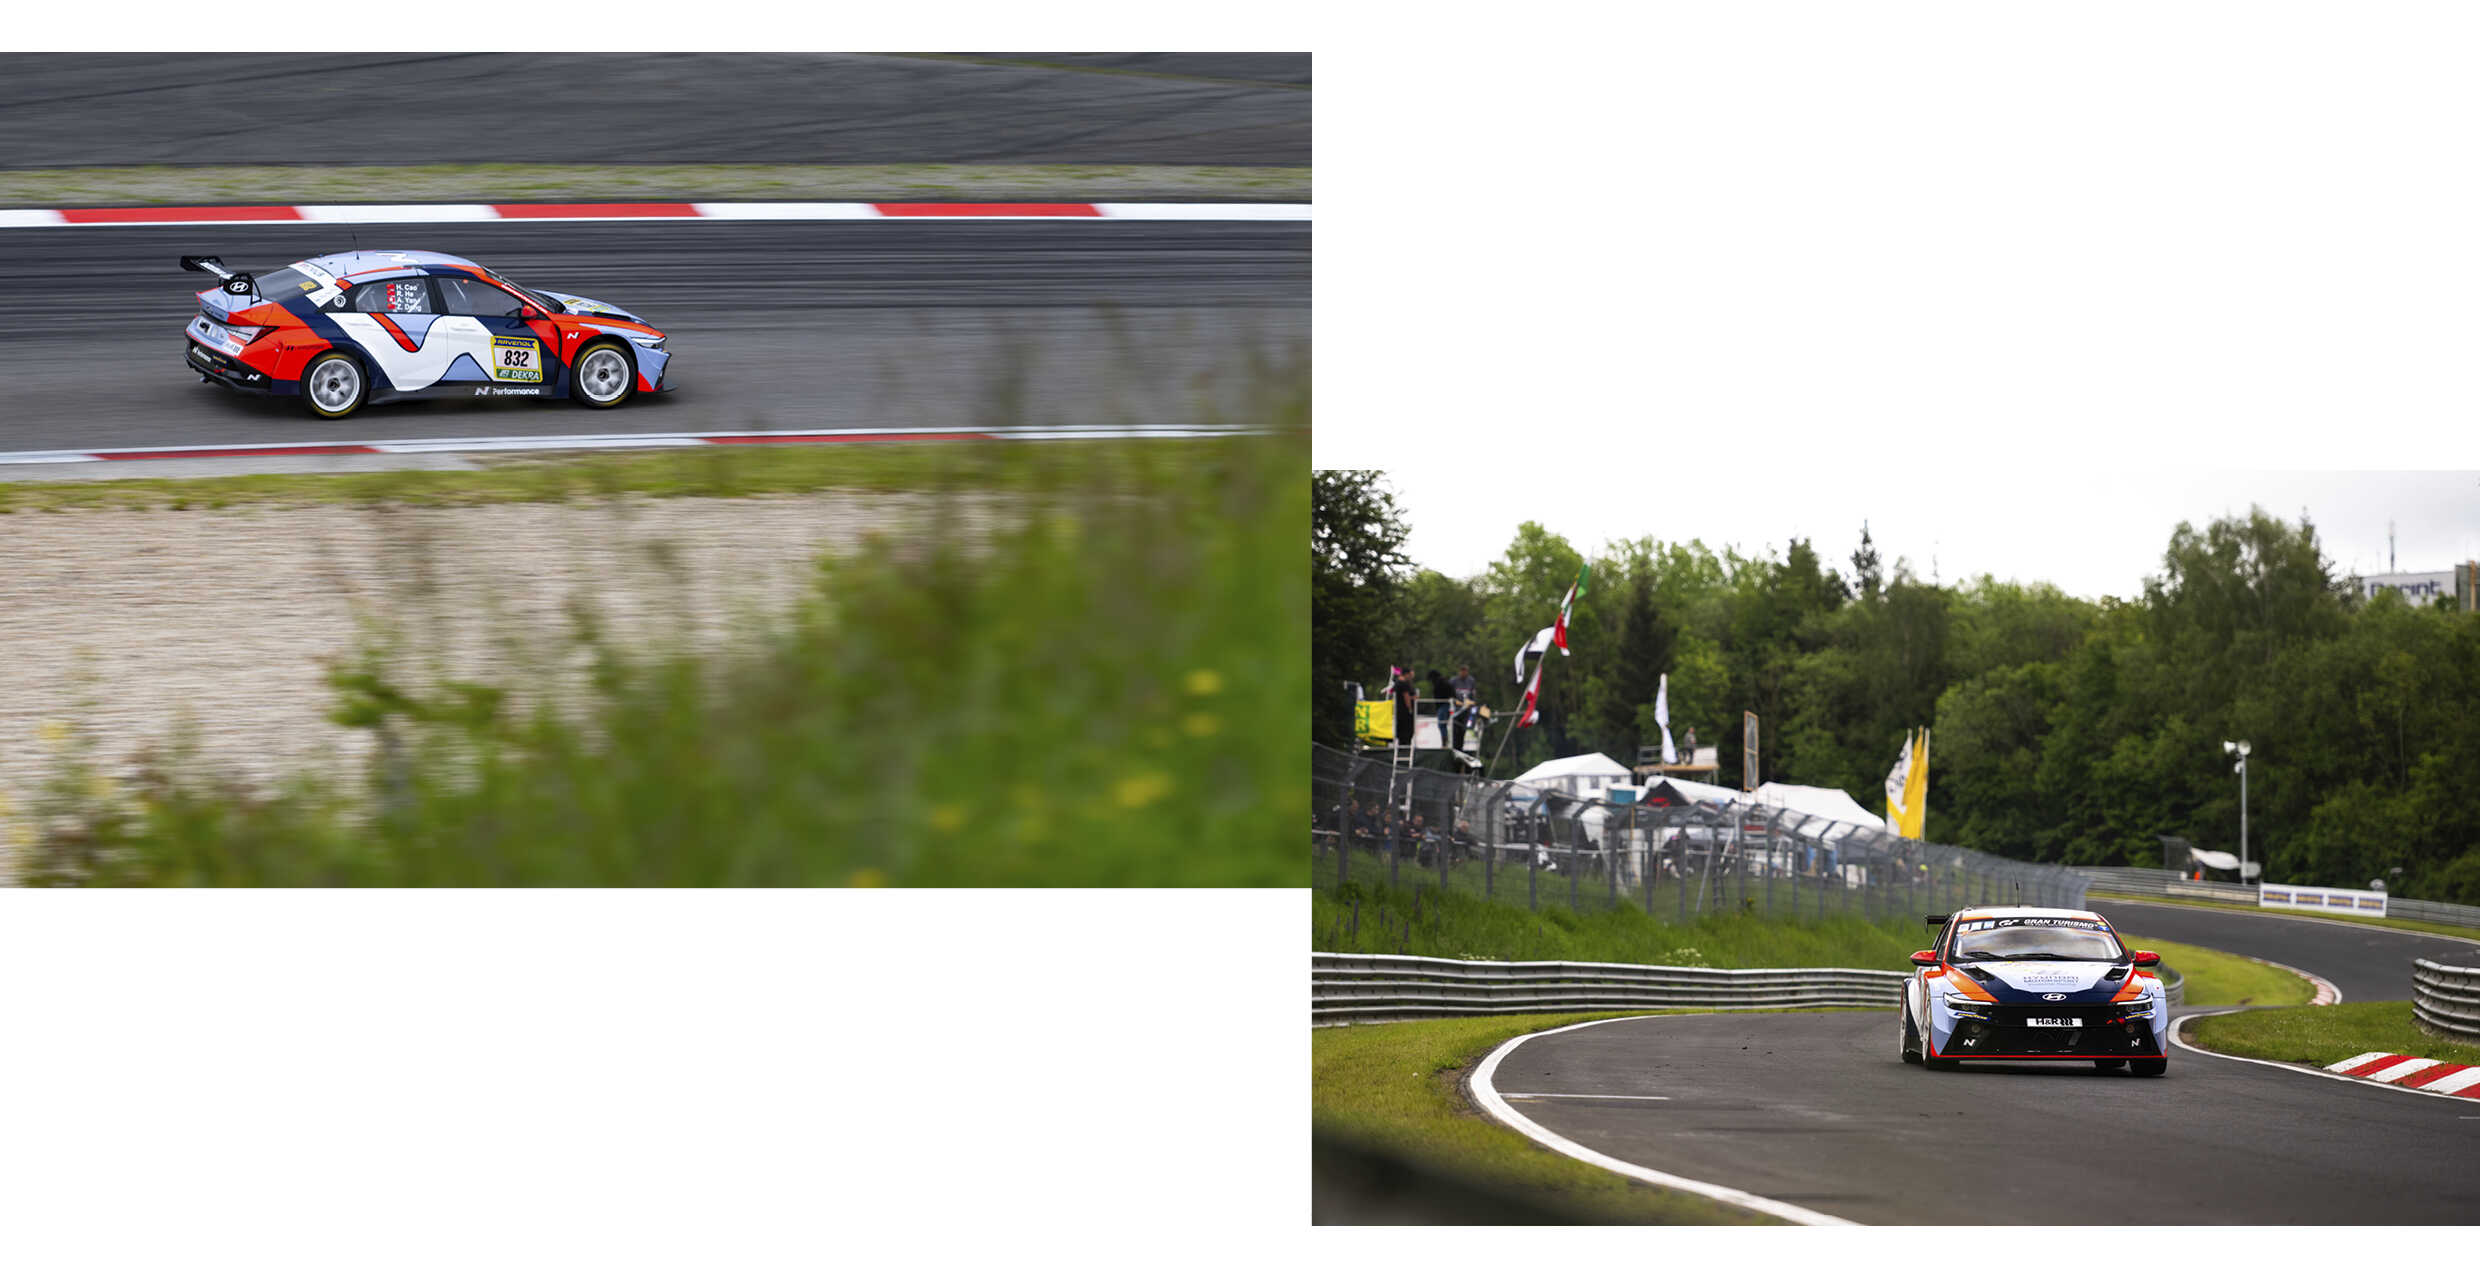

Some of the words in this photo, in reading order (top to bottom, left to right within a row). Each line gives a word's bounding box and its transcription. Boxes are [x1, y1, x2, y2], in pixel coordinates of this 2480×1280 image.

[503, 350, 530, 367] 832
[511, 371, 540, 380] DEKRA
[492, 387, 540, 395] Performance
[2024, 918, 2050, 926] GRAN
[2053, 919, 2098, 929] TURISMO
